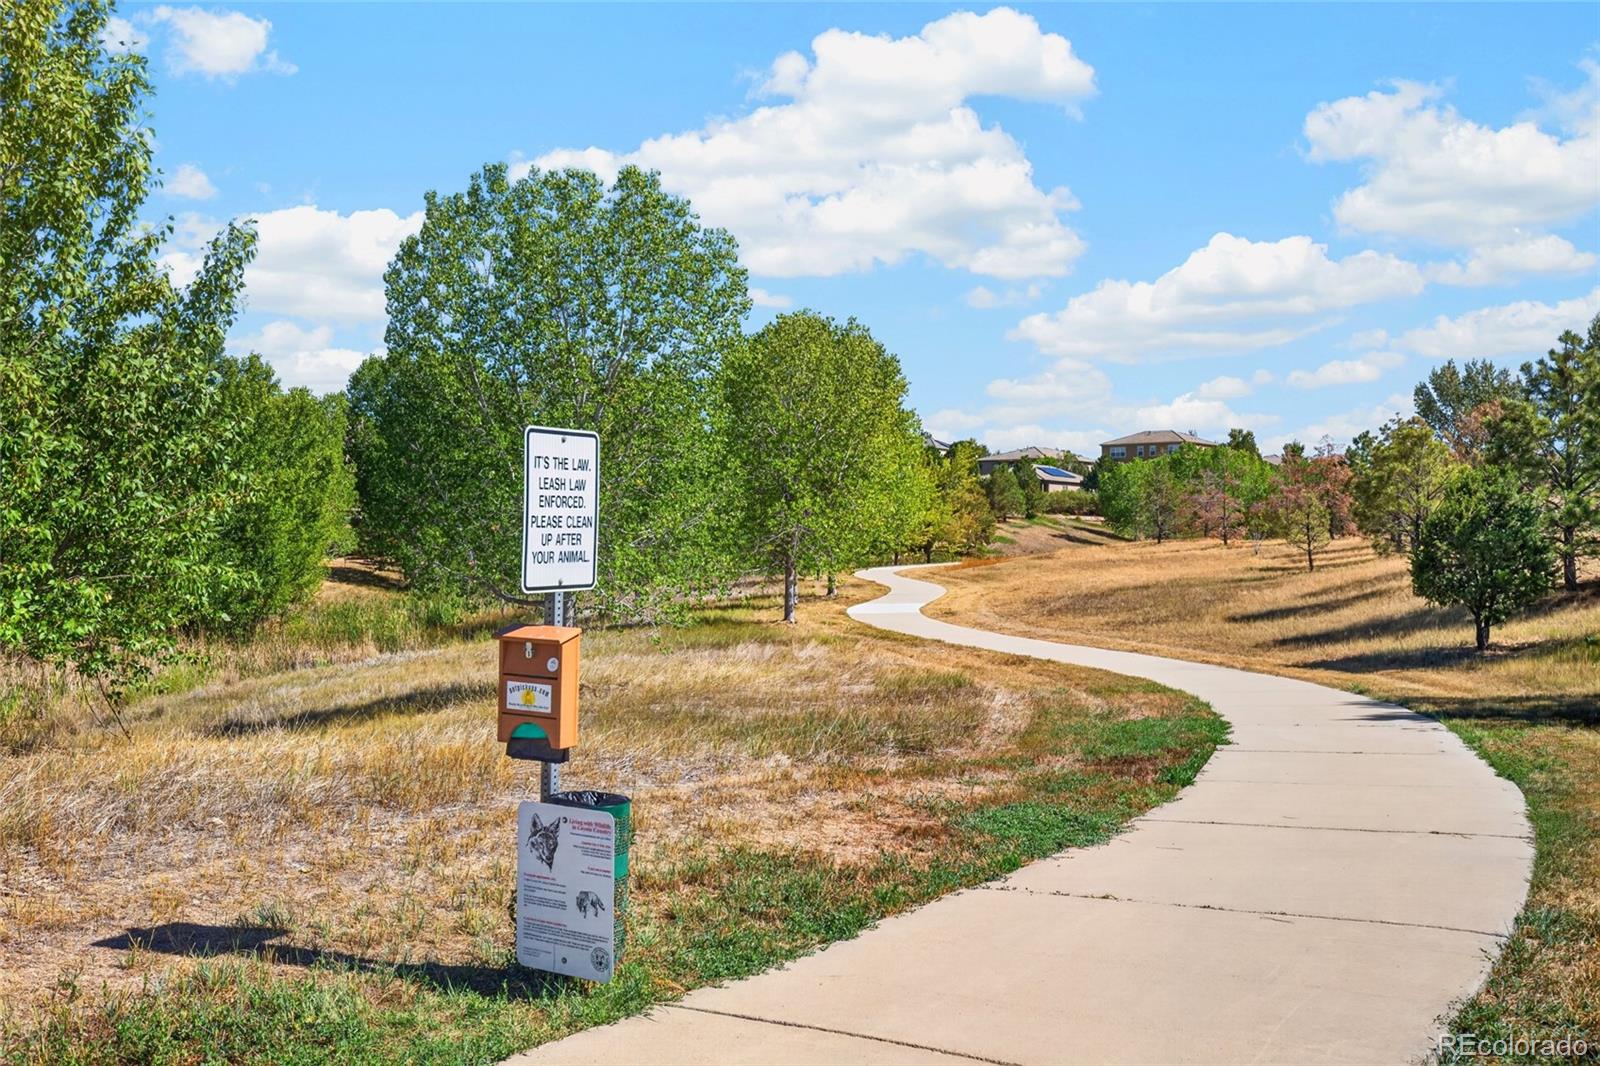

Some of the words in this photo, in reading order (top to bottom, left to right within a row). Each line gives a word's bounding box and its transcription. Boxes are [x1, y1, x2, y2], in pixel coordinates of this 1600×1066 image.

[534, 455, 550, 470] IT'S
[553, 456, 569, 471] THE
[572, 458, 592, 472] LAW.
[538, 477, 566, 491] LEASH
[569, 478, 587, 492] LAW
[538, 495, 586, 509] ENFORCED.
[530, 515, 563, 529] PLEASE
[566, 516, 593, 529] CLEAN
[541, 533, 553, 547] UP
[555, 533, 582, 546] AFTER
[531, 551, 555, 565] YOUR
[557, 551, 590, 564] ANIMAL.
